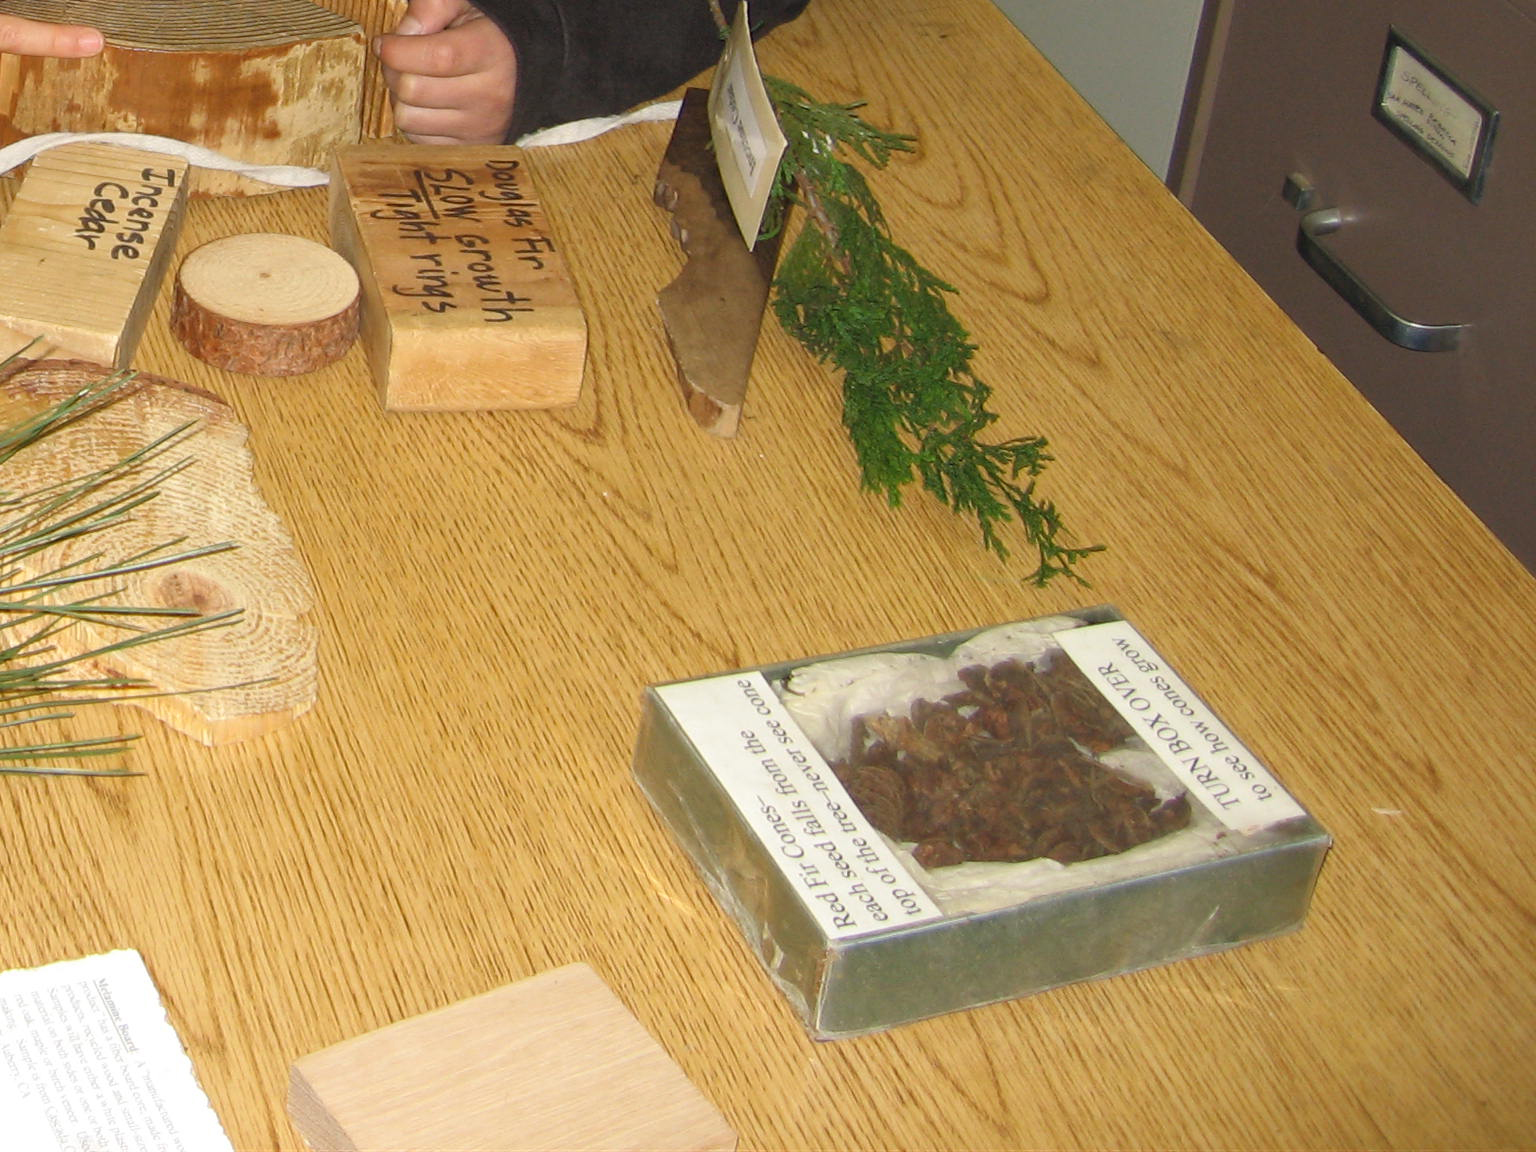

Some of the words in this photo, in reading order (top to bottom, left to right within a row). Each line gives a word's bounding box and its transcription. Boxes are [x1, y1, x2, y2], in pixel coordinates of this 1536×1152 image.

[74, 181, 129, 250] Cedar
[111, 167, 175, 260] Incense
[370, 189, 453, 244] Tight
[478, 159, 538, 228] Douglas
[511, 235, 556, 270] Fir
[391, 253, 459, 313] rings
[1112, 639, 1159, 672] grow
[738, 681, 771, 715] cone
[1098, 662, 1150, 711] OVER
[1150, 676, 1194, 716] cones
[741, 731, 766, 754] the
[767, 721, 793, 744] see
[1144, 713, 1192, 754] BOX
[1191, 722, 1229, 754] how
[762, 759, 797, 795] from
[1182, 757, 1240, 810] TURN
[1225, 756, 1255, 780] see
[1252, 784, 1272, 801] to
[792, 801, 825, 835] falls
[814, 842, 857, 878] seed
[853, 839, 879, 863] the
[800, 864, 827, 888] Fir
[866, 867, 896, 884] of
[816, 893, 856, 928] Red
[849, 884, 888, 921] each
[892, 889, 921, 915] top
[92, 977, 122, 1025] Melamine
